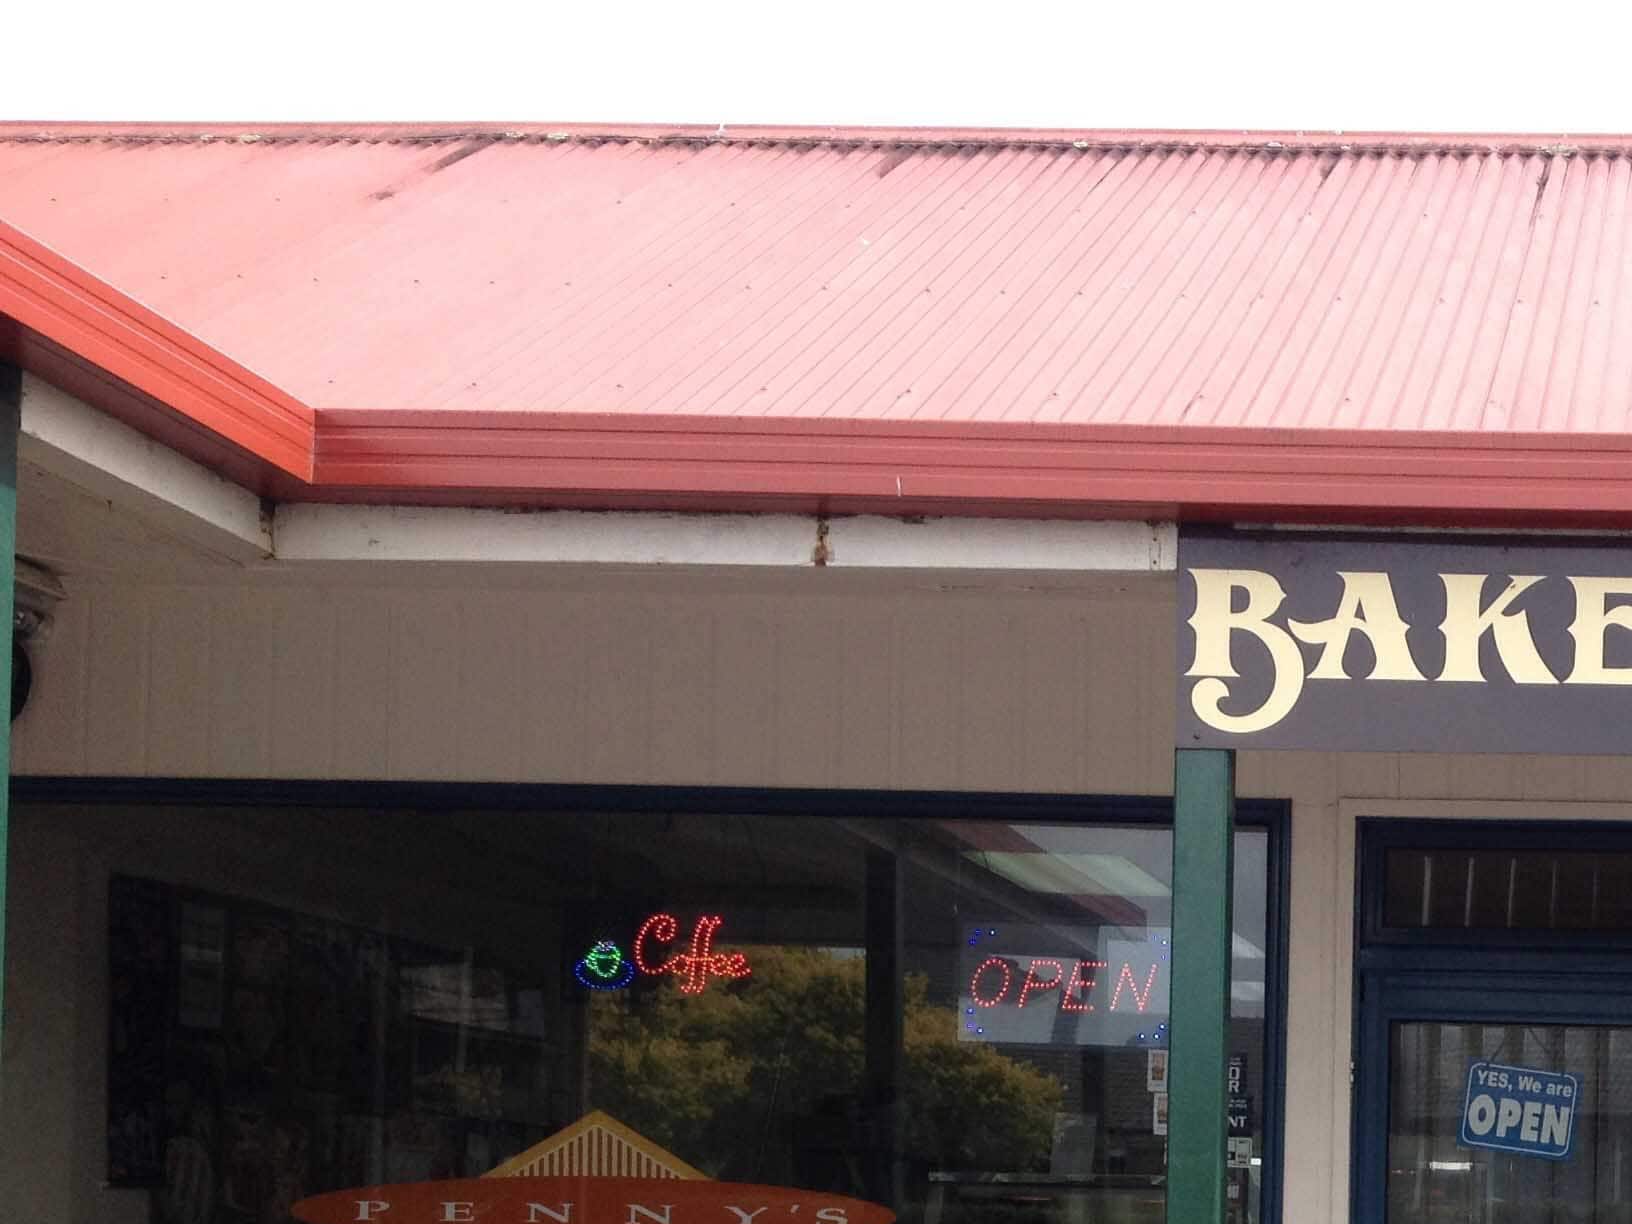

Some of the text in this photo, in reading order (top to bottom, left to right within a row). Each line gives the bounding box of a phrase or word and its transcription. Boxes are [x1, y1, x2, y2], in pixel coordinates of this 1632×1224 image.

[633, 913, 752, 994] Coffee
[970, 956, 1158, 1013] OPEN
[1477, 1070, 1573, 1098] YES, We are
[1468, 1094, 1570, 1146] OPEN
